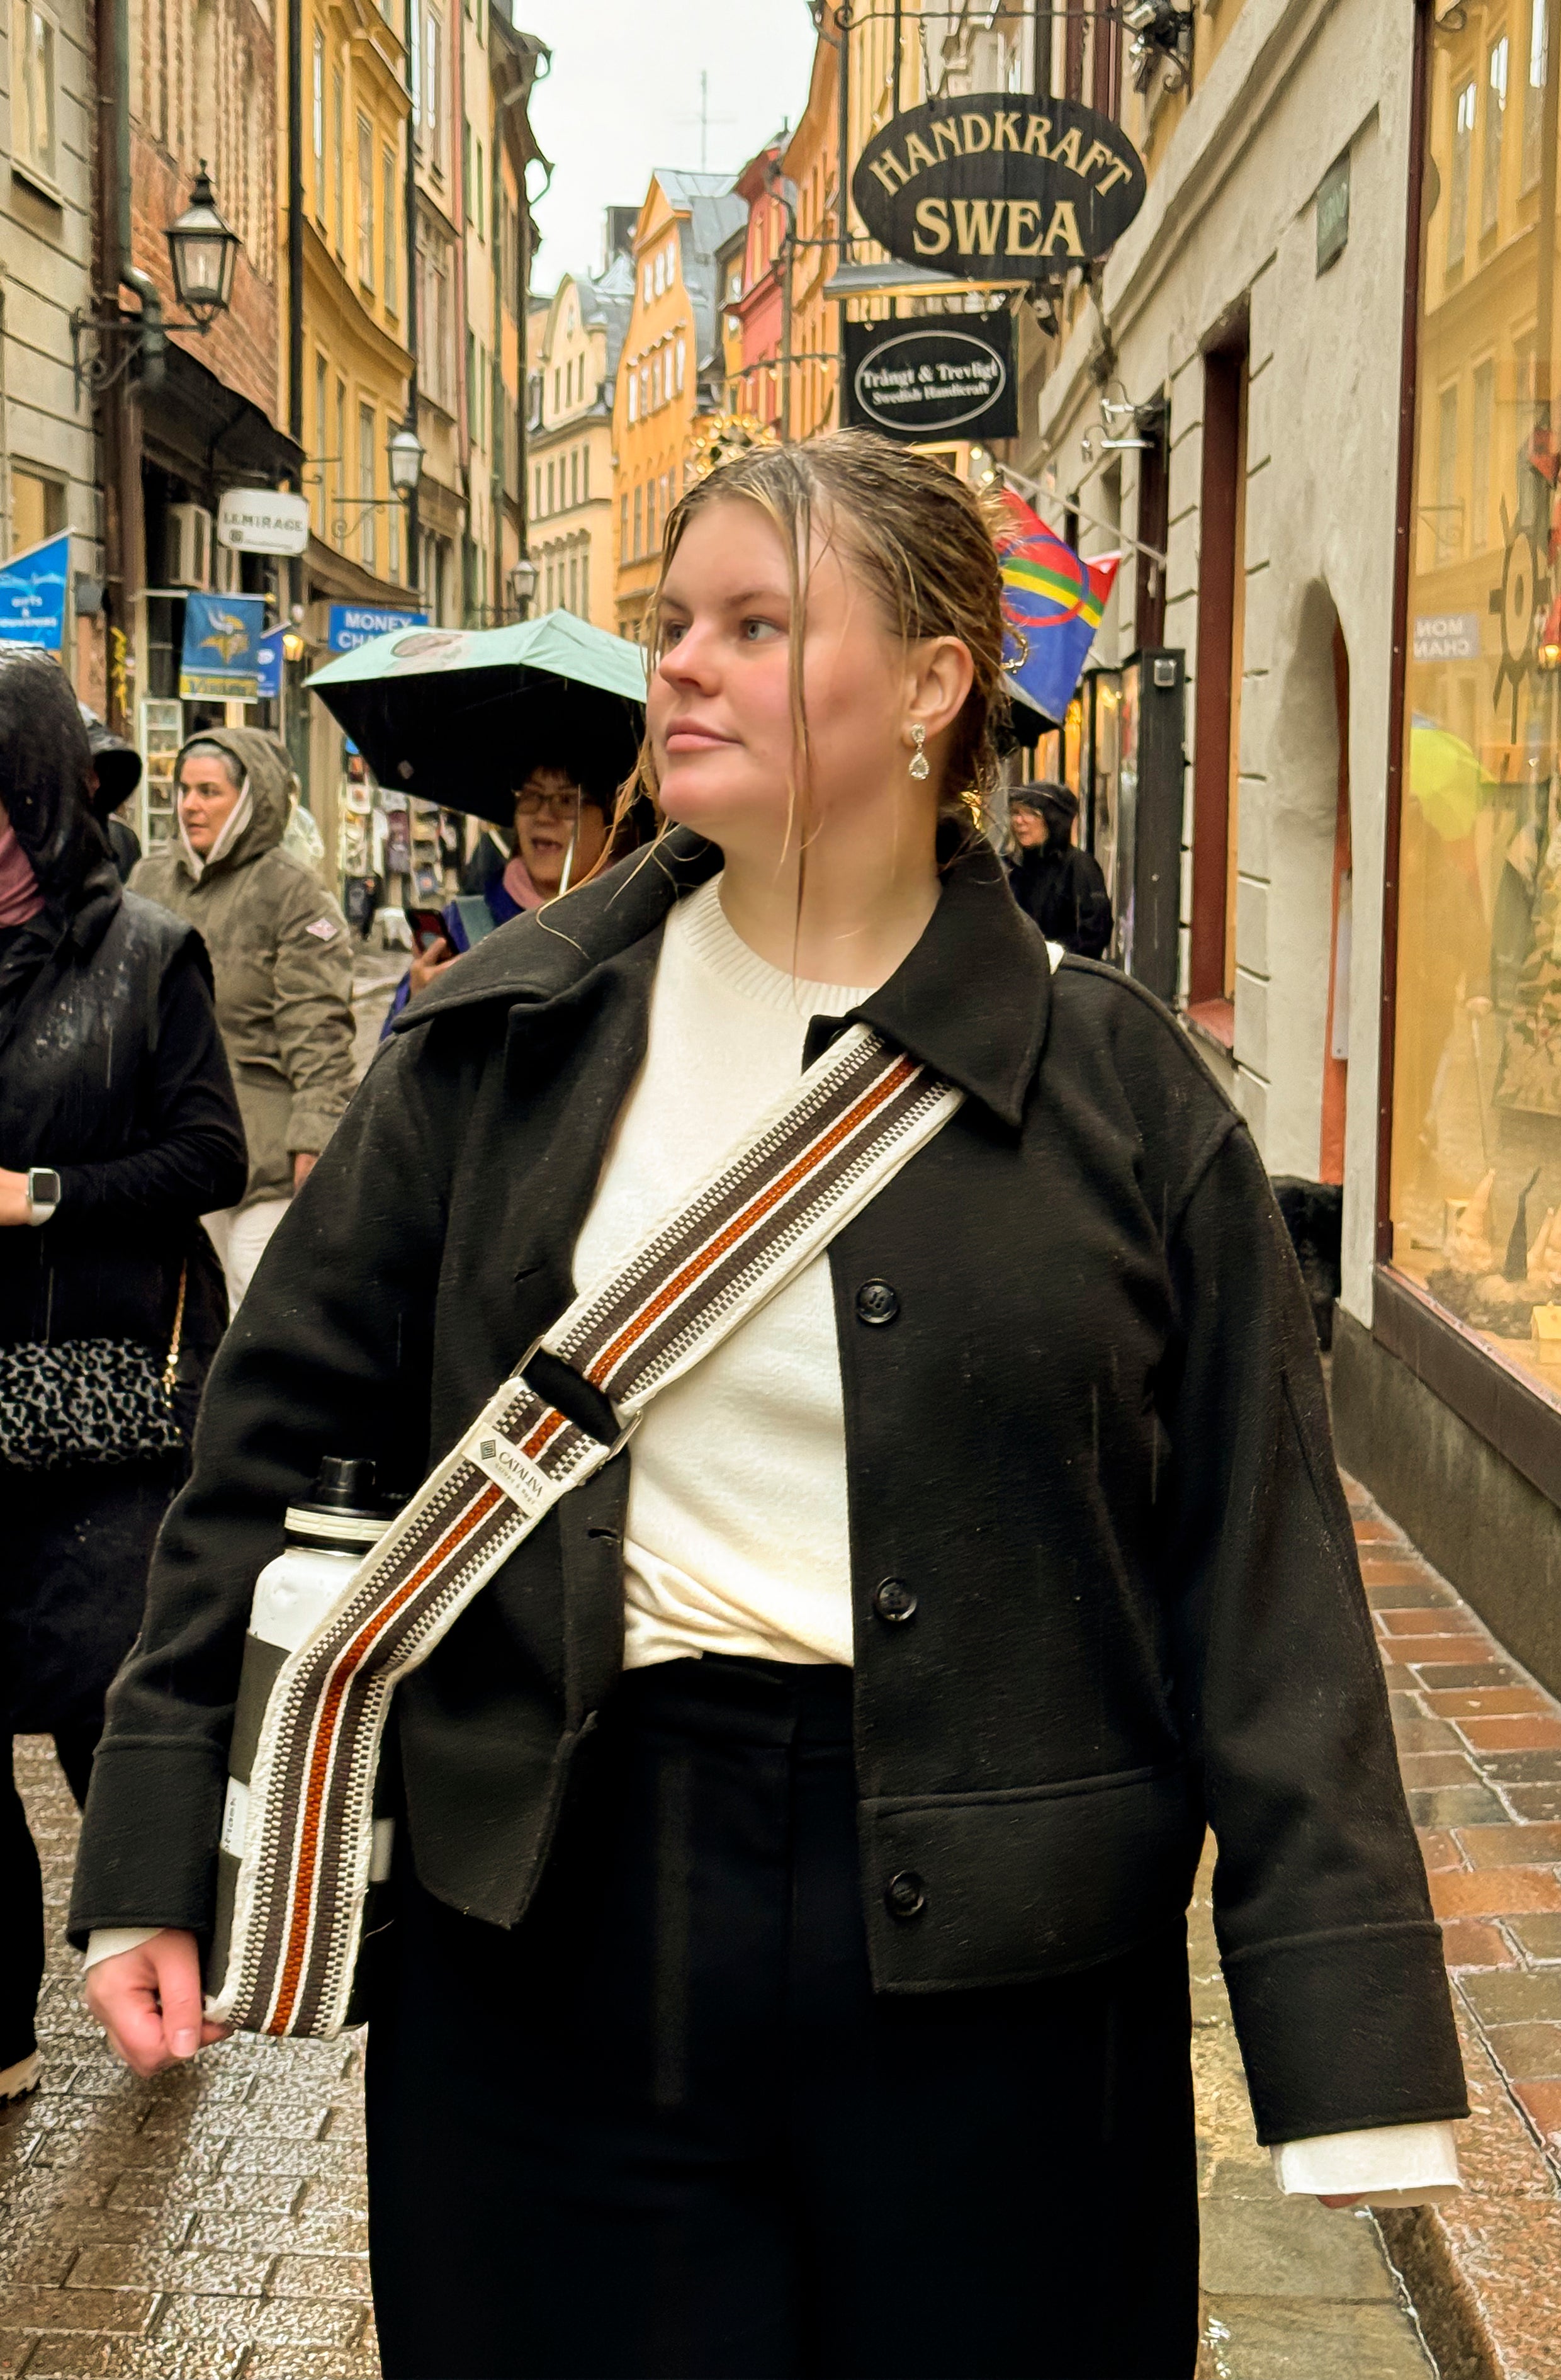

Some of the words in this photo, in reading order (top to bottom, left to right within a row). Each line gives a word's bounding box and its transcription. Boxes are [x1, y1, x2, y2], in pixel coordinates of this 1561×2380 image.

[869, 111, 1132, 197] HANDKRAFT
[913, 198, 1085, 256] SWEA
[918, 364, 934, 383] &
[345, 610, 412, 631] MONEY
[338, 630, 376, 649] CHA
[499, 1451, 543, 1497] CATALINA
